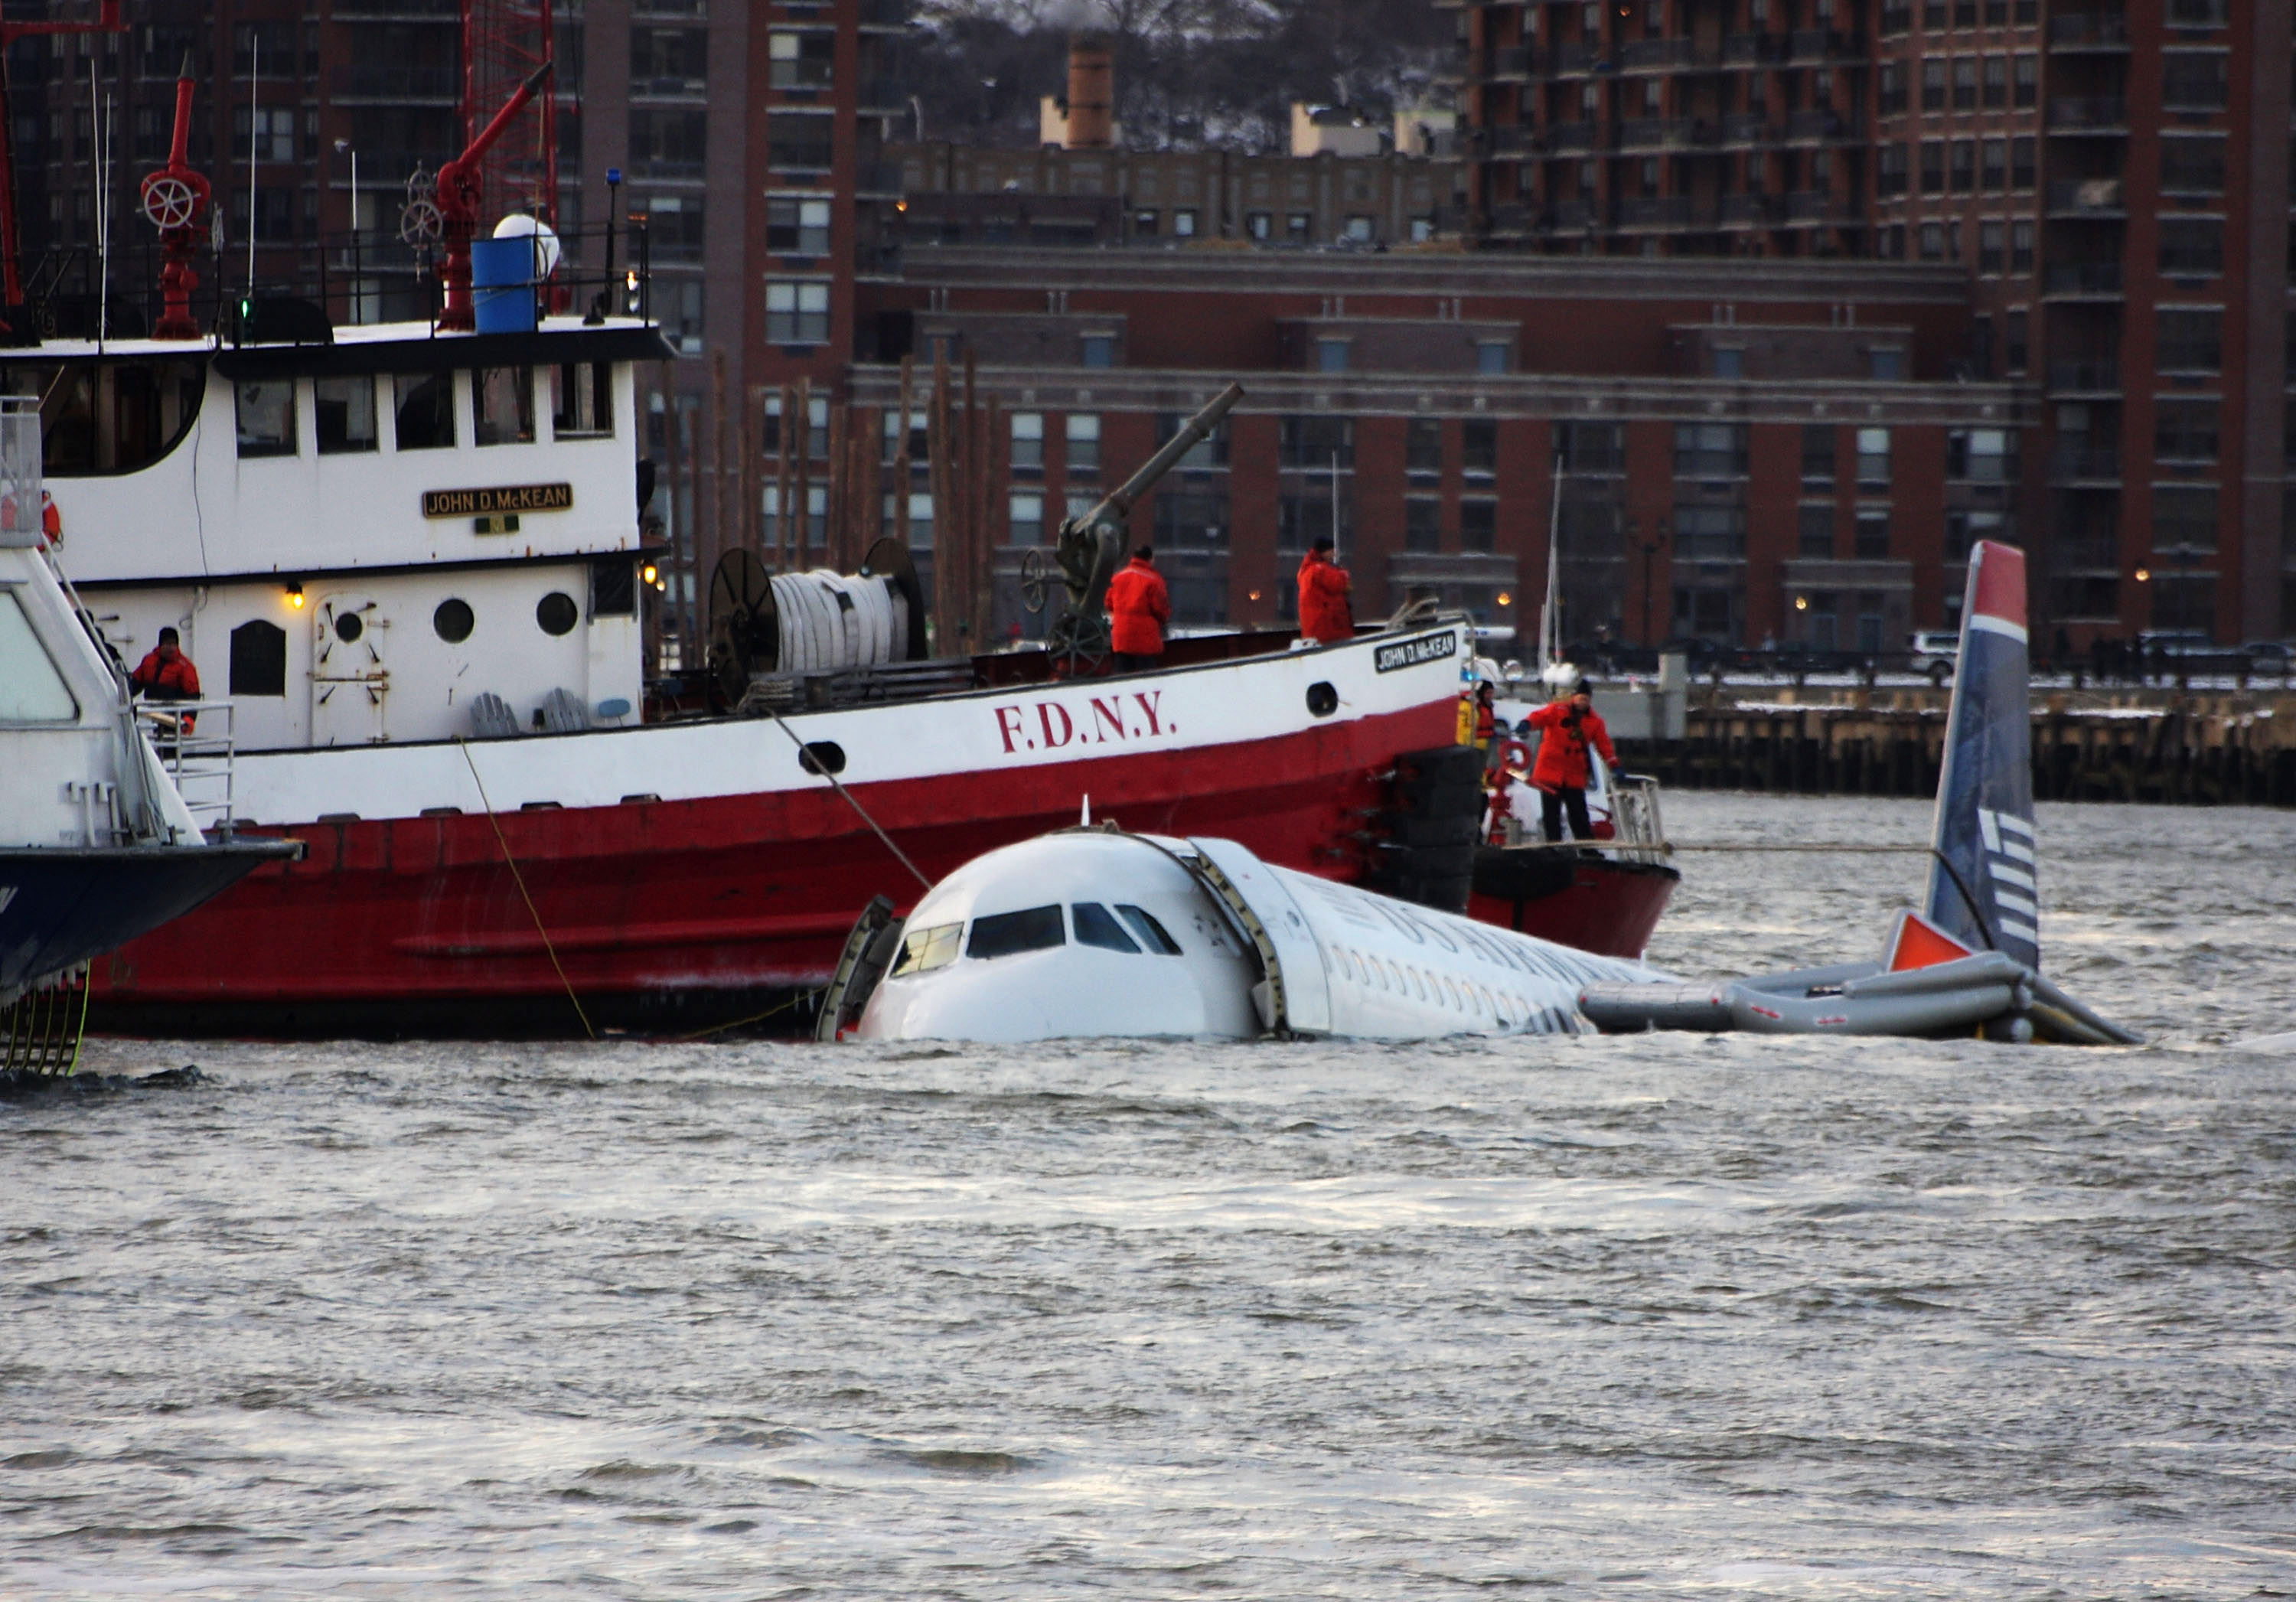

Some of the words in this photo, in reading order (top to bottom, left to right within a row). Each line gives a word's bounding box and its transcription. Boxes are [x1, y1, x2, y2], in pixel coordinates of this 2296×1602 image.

[428, 492, 474, 514] JOHN
[479, 491, 496, 511] D.
[497, 486, 568, 510] McKEAN
[1378, 646, 1406, 670] JOHN
[993, 690, 1177, 754] F.D.N.Y.
